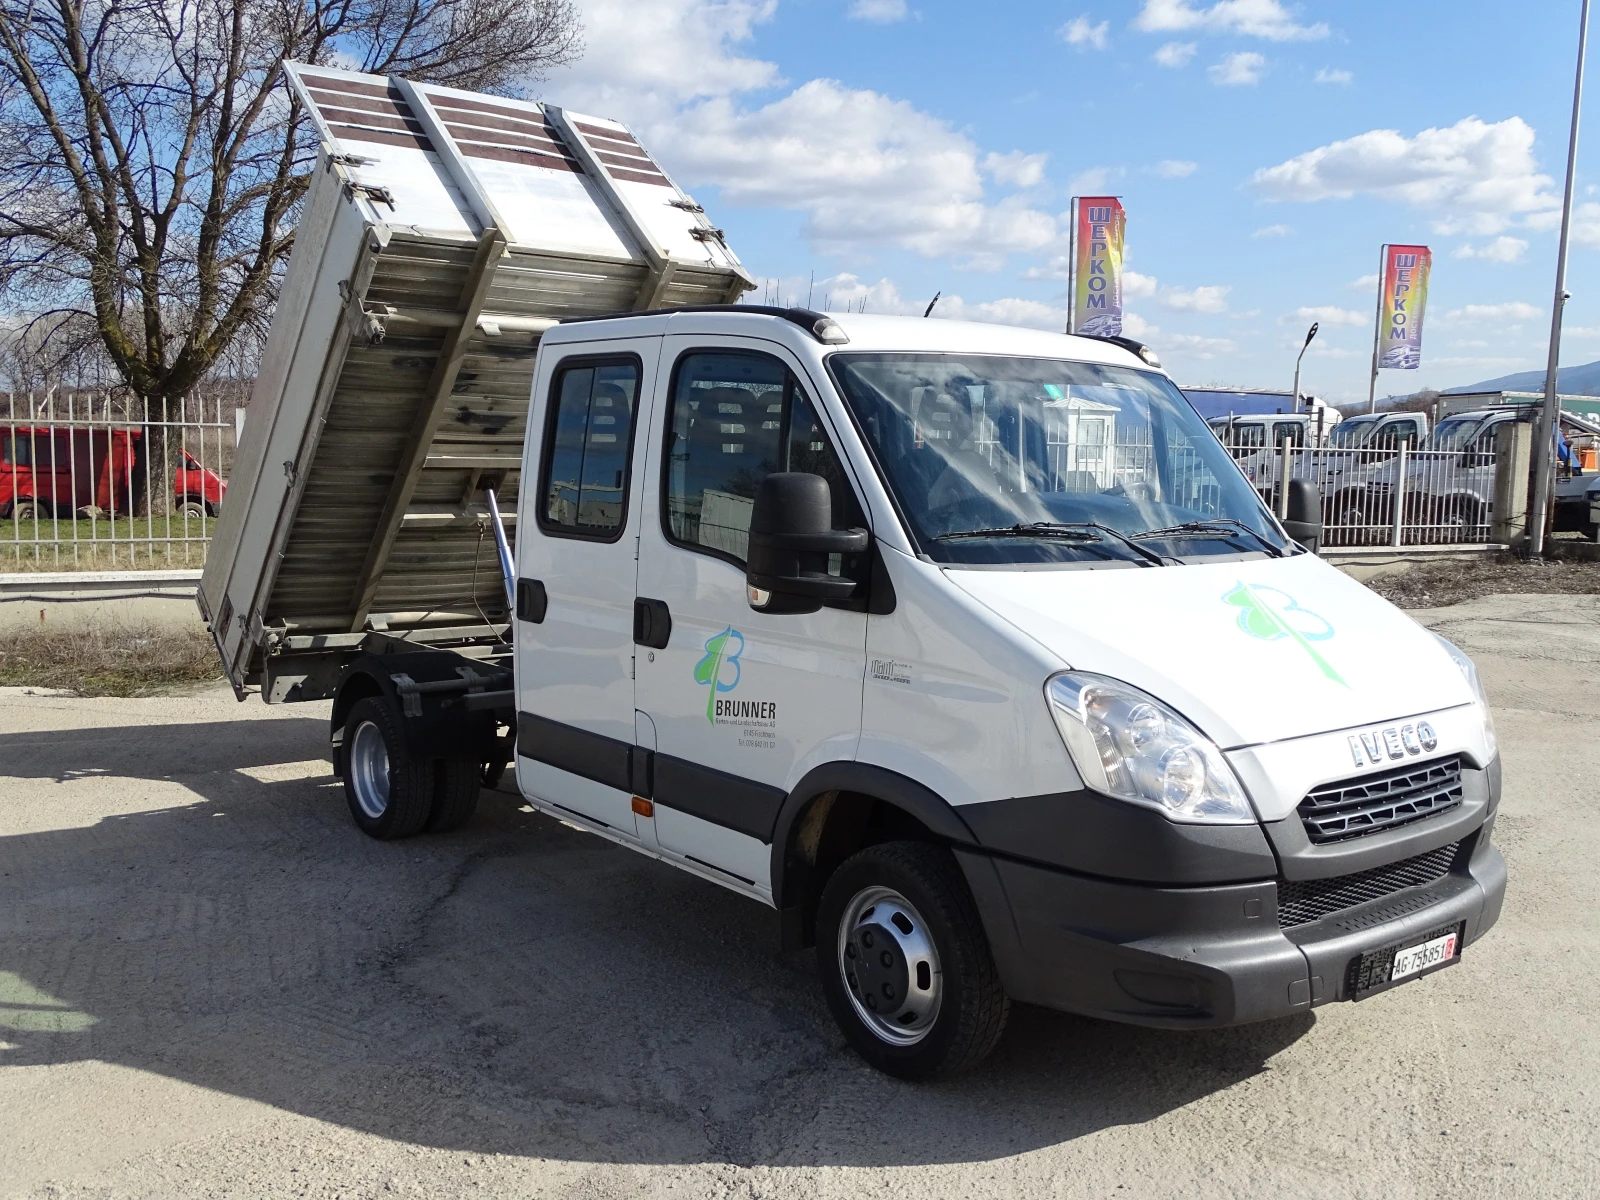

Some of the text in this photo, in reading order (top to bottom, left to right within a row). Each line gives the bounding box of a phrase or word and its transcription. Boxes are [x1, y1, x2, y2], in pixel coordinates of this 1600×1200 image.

[1086, 206, 1112, 309] ШЕРКОМ
[1389, 253, 1417, 340] ШЕРКОМ
[715, 699, 777, 720] BRUNNER
[1347, 720, 1438, 768] IVECO
